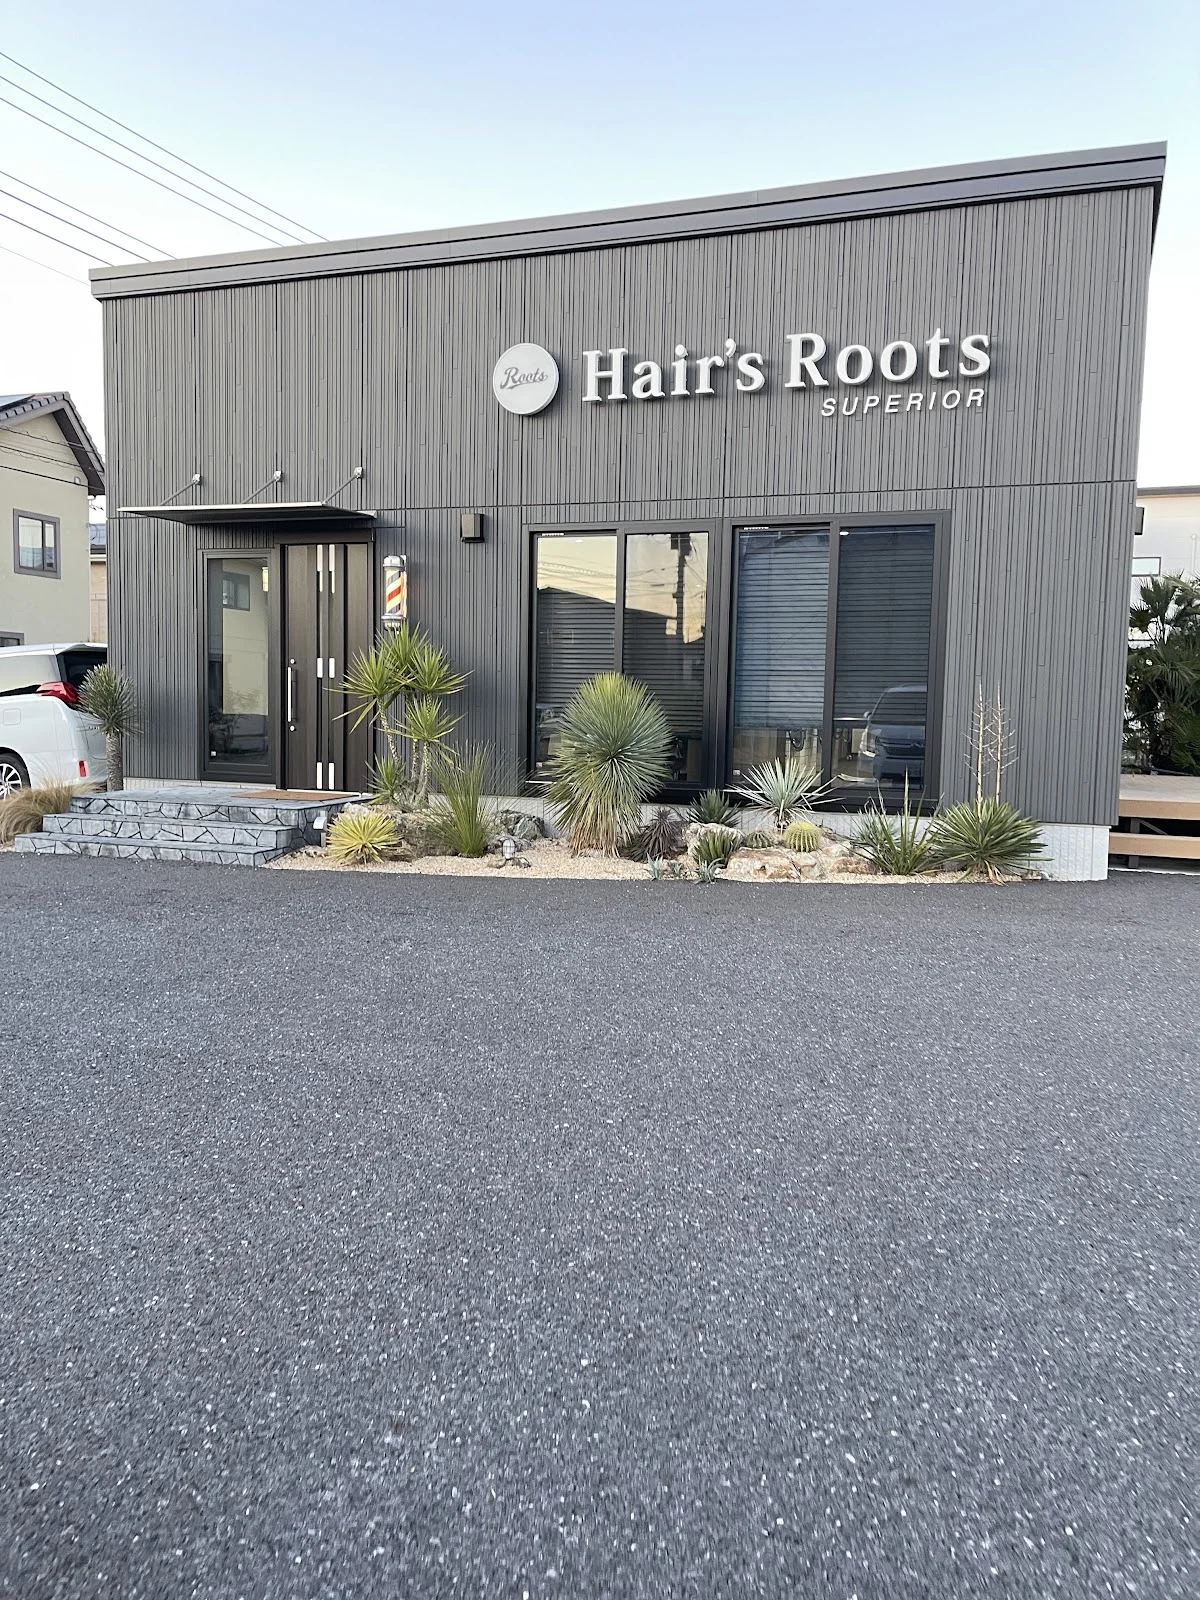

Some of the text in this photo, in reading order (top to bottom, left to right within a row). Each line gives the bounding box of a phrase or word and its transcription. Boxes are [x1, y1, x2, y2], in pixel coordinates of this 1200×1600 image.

[500, 366, 548, 389] Roots
[582, 327, 991, 402] Hair's Roots
[821, 388, 984, 417] SUPERIOR
